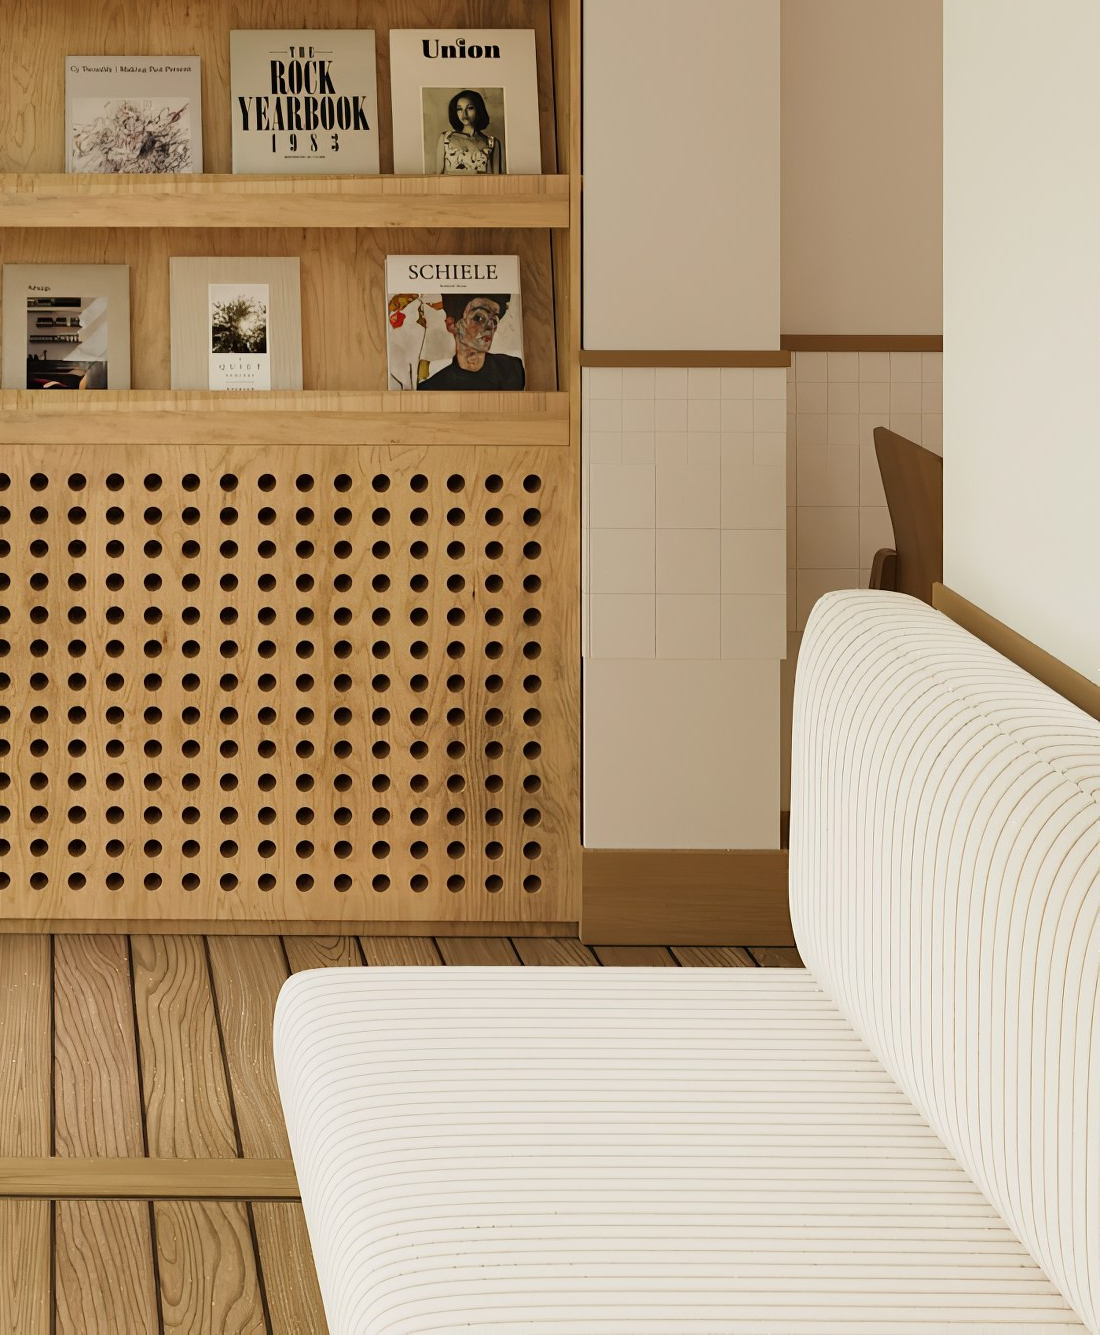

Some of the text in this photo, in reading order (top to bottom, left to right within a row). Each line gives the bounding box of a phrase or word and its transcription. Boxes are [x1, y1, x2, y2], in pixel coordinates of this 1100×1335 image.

[289, 46, 315, 58] THE
[422, 38, 500, 59] Union
[270, 60, 336, 94] ROCK
[238, 95, 370, 131] YEARBOOK
[408, 264, 498, 280] SCHIELE
